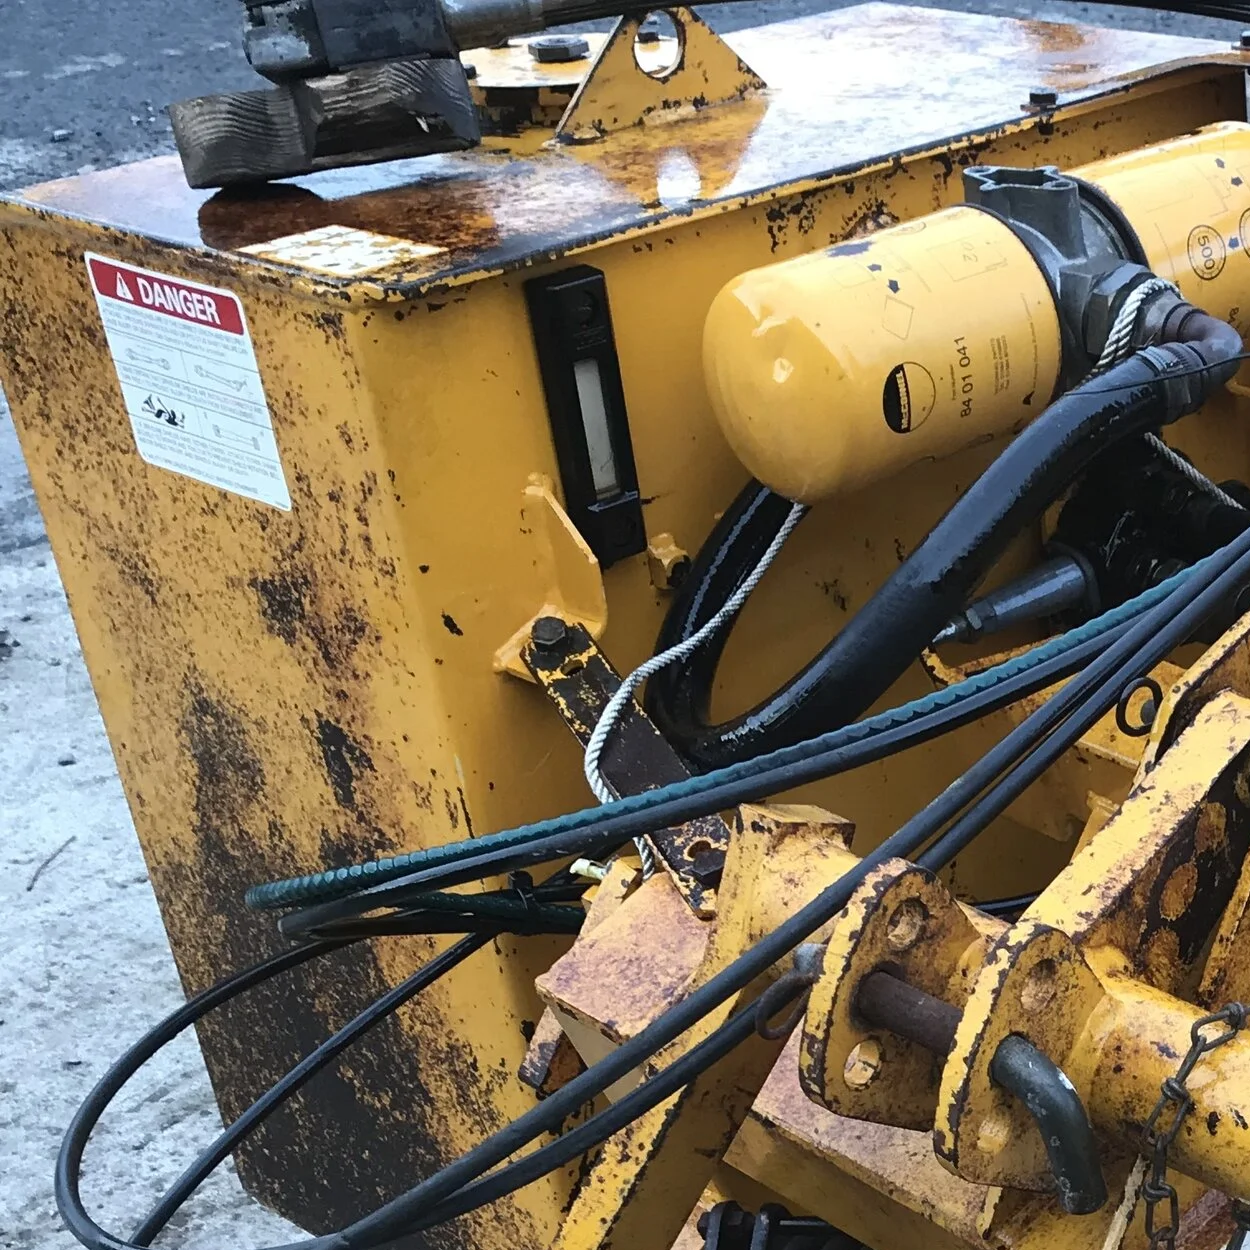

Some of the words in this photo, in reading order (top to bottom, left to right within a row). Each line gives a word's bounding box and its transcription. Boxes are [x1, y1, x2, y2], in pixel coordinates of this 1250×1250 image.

[1197, 235, 1216, 270] 500
[136, 276, 222, 325] DANGER
[953, 336, 971, 368] 041
[961, 374, 974, 394] 01
[960, 397, 973, 418] 84
